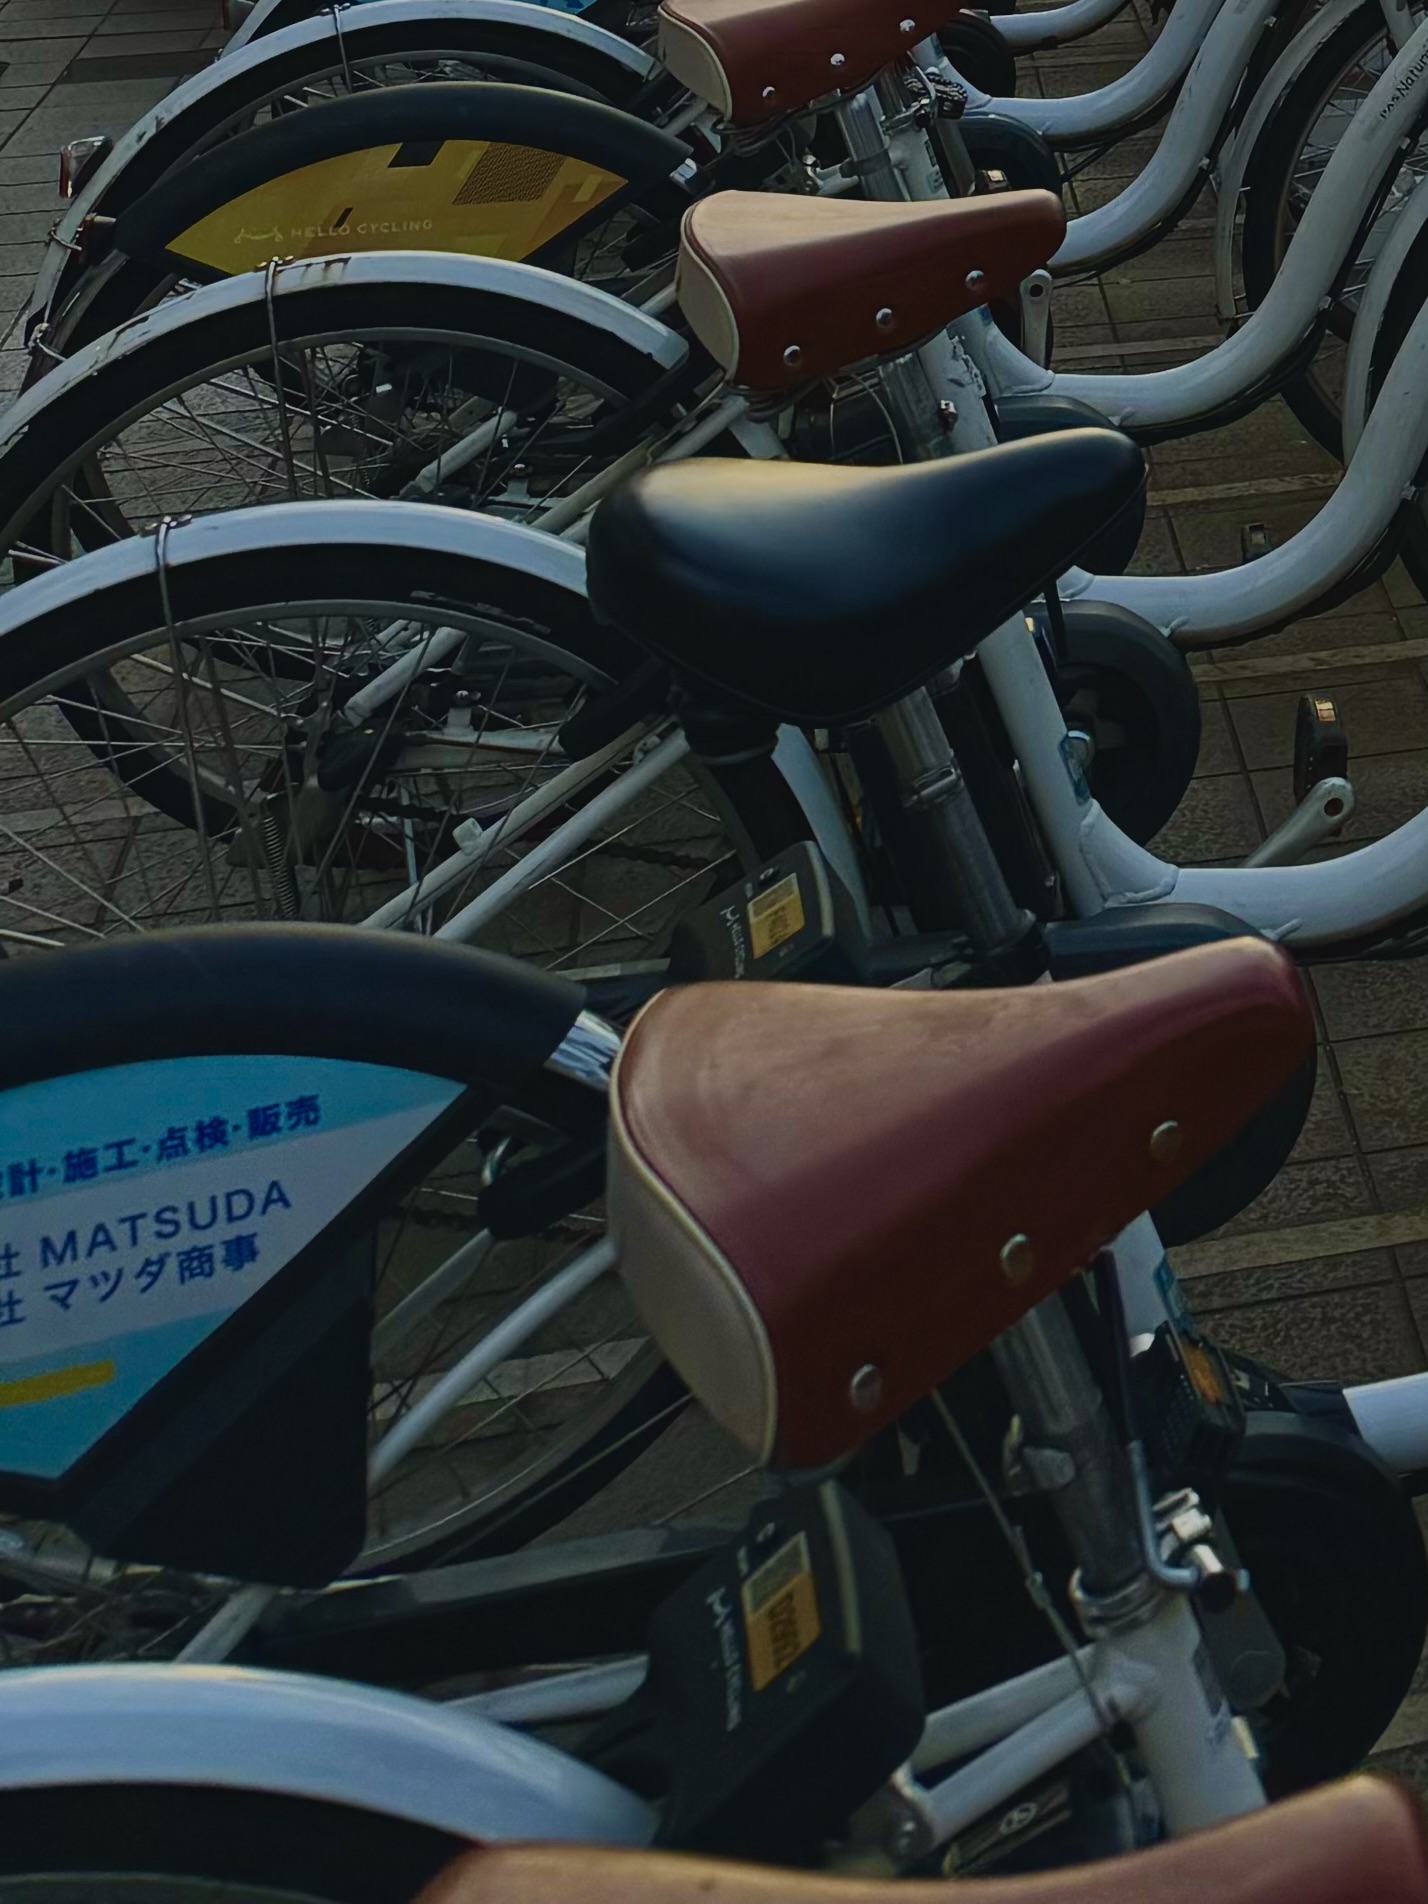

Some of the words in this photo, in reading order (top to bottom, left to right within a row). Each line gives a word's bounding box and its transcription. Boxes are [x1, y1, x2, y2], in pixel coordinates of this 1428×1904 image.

[290, 225, 350, 239] HELLO
[356, 218, 433, 235] CYCLING
[0, 1094, 320, 1198] 計・施工・点検・販売
[39, 1179, 292, 1269] MATSUDA
[43, 1231, 259, 1311] マツダ商事
